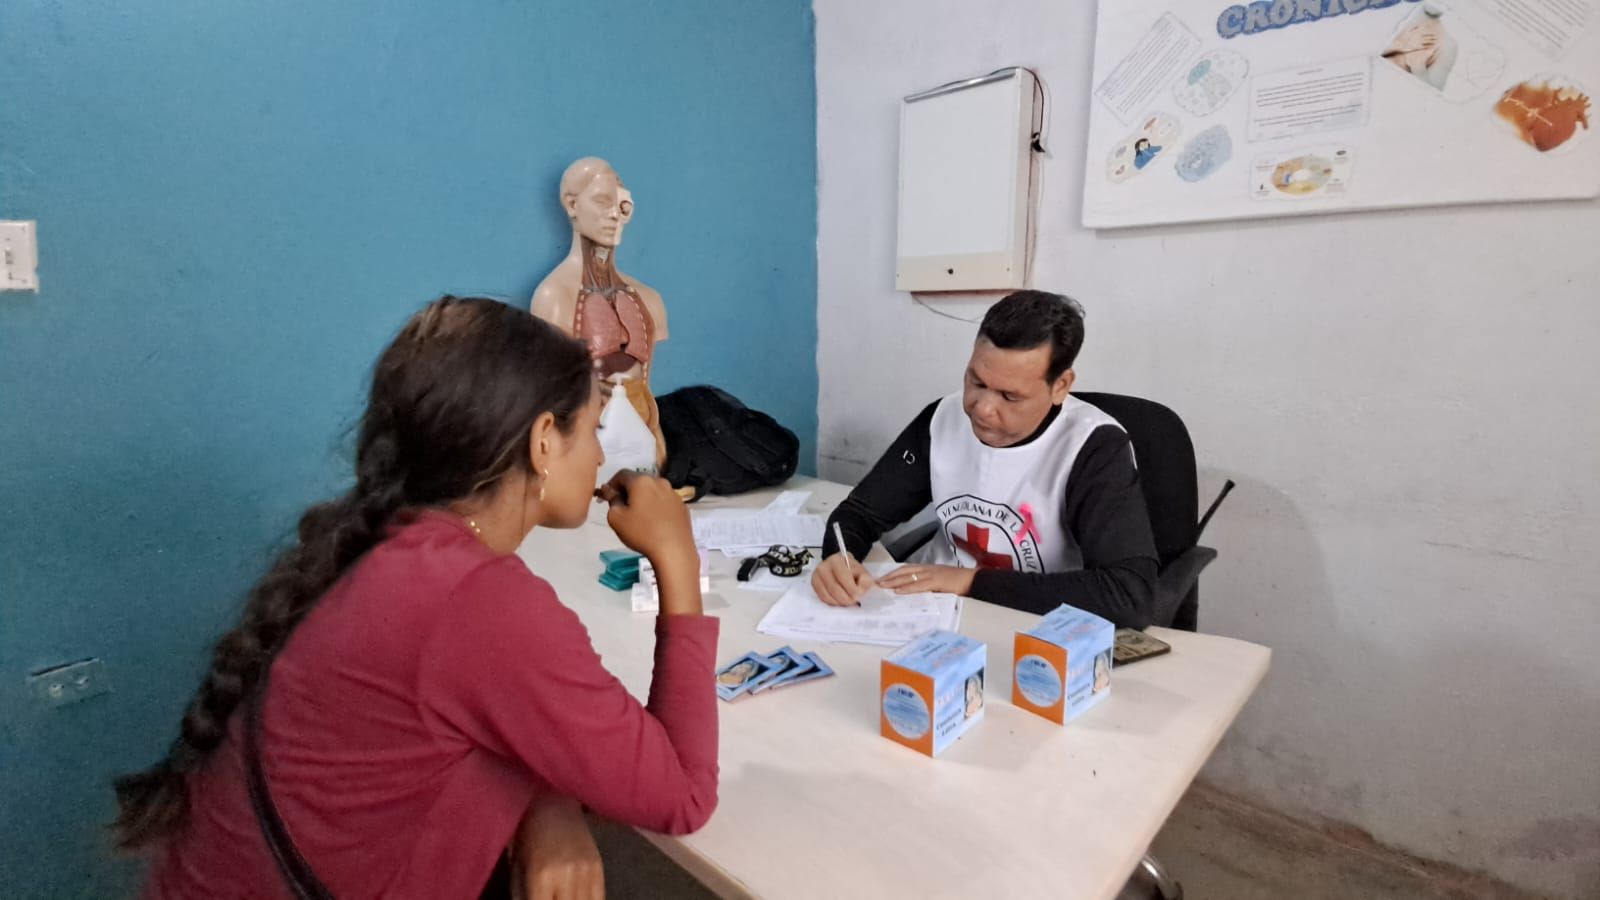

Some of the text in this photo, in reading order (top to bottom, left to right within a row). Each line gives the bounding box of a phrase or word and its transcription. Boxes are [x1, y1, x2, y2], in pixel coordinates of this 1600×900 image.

[1217, 0, 1421, 39] CRONI
[995, 509, 1010, 522] DE
[1019, 539, 1038, 570] CRUZ
